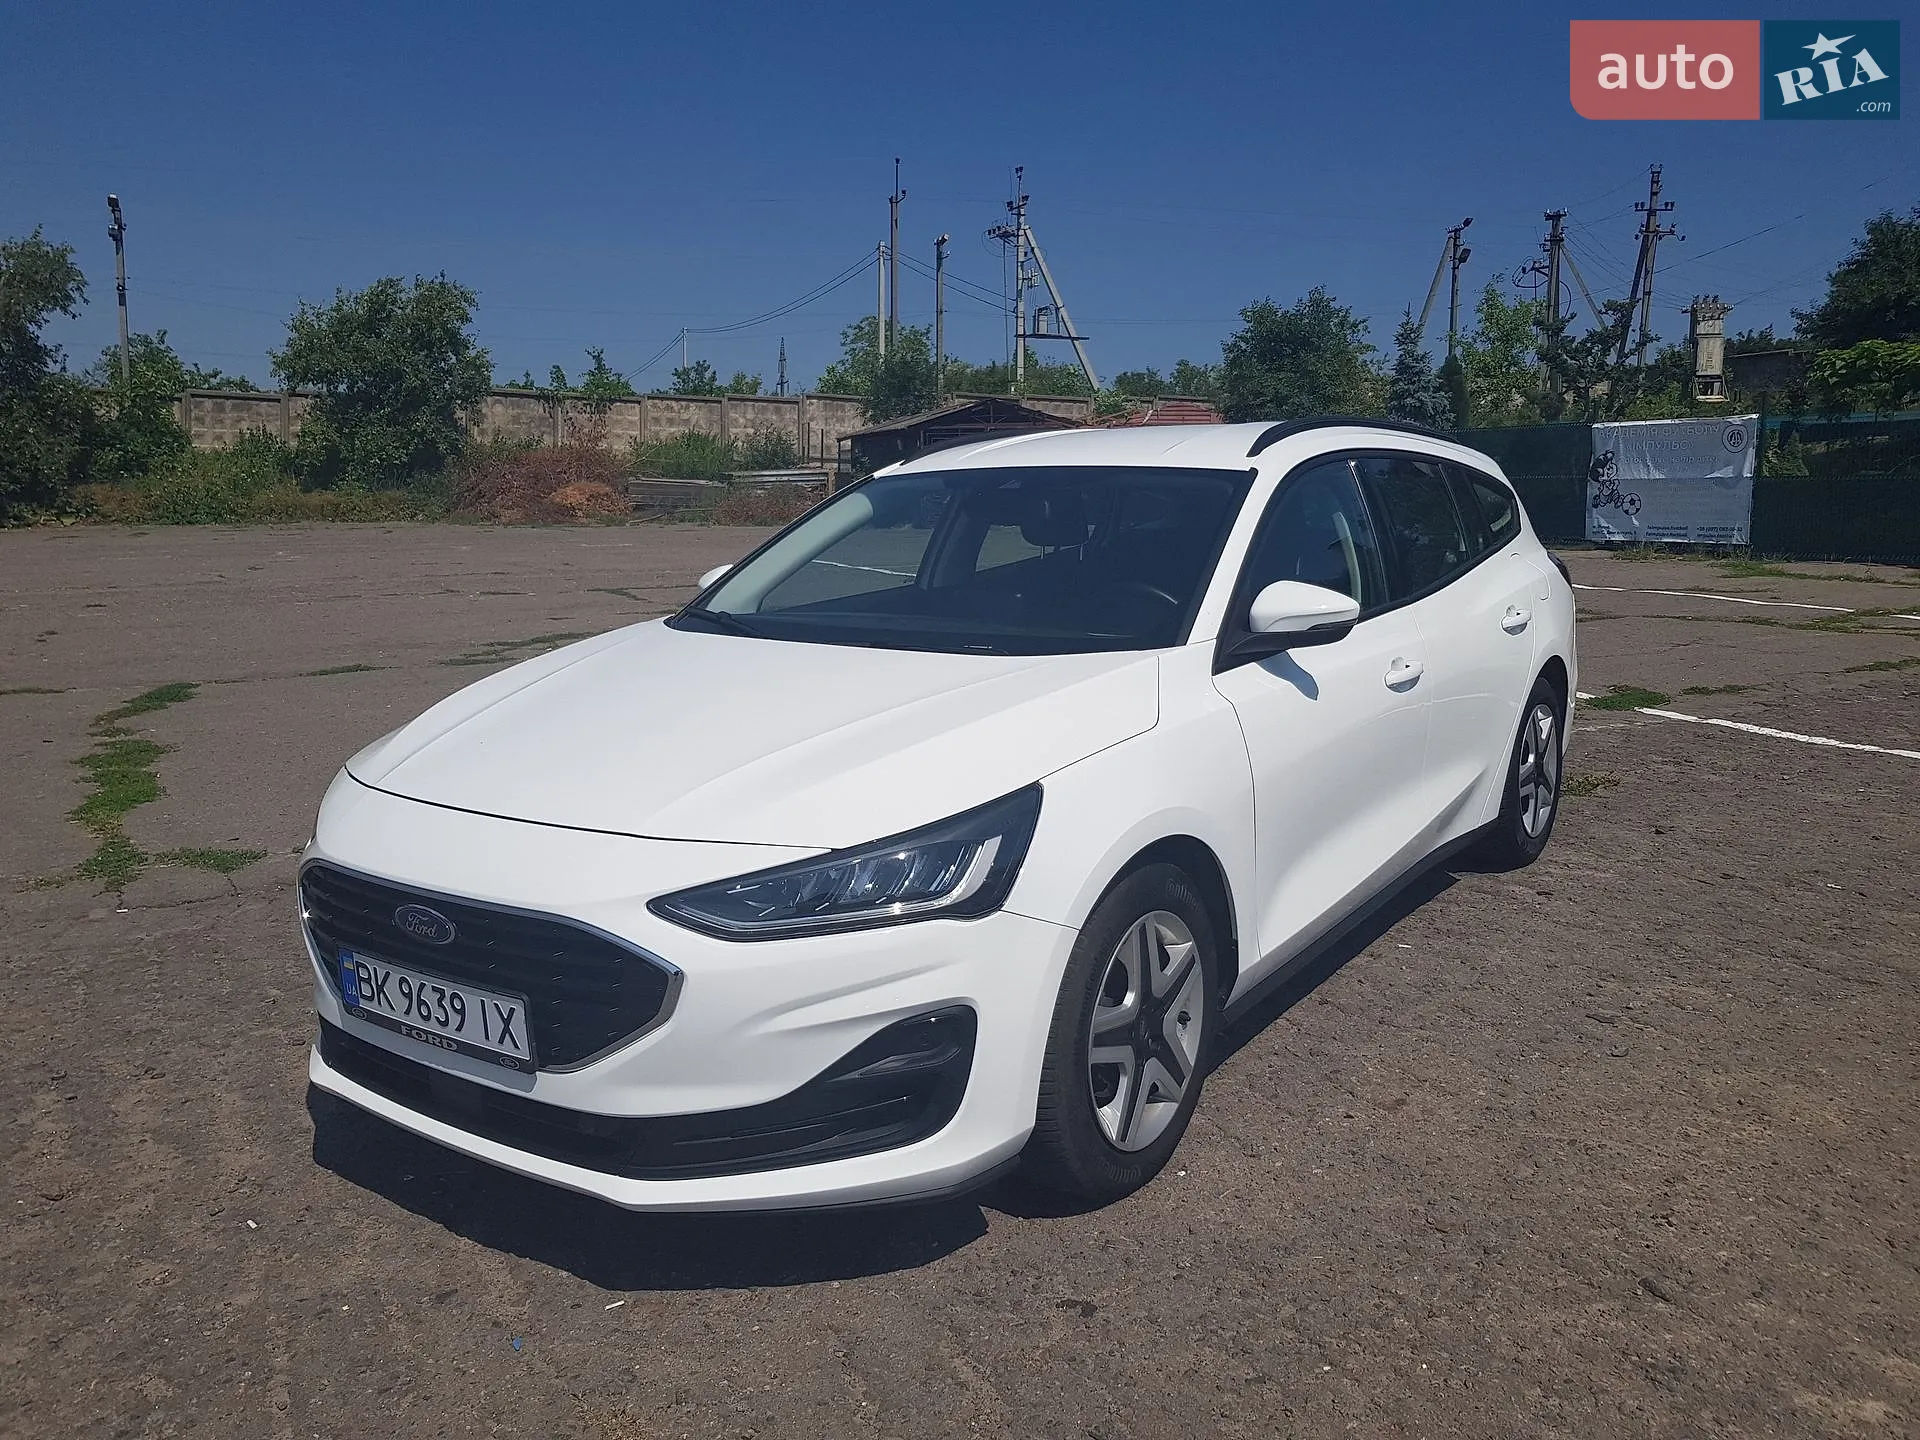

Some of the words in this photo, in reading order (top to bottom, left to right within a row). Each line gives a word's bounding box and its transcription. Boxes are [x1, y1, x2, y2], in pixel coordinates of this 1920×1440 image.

[405, 912, 439, 939] Ford
[346, 983, 358, 996] UA
[355, 960, 397, 1013] BK
[398, 975, 467, 1033] 9639
[480, 997, 521, 1050] IX
[400, 1025, 458, 1051] FORD
